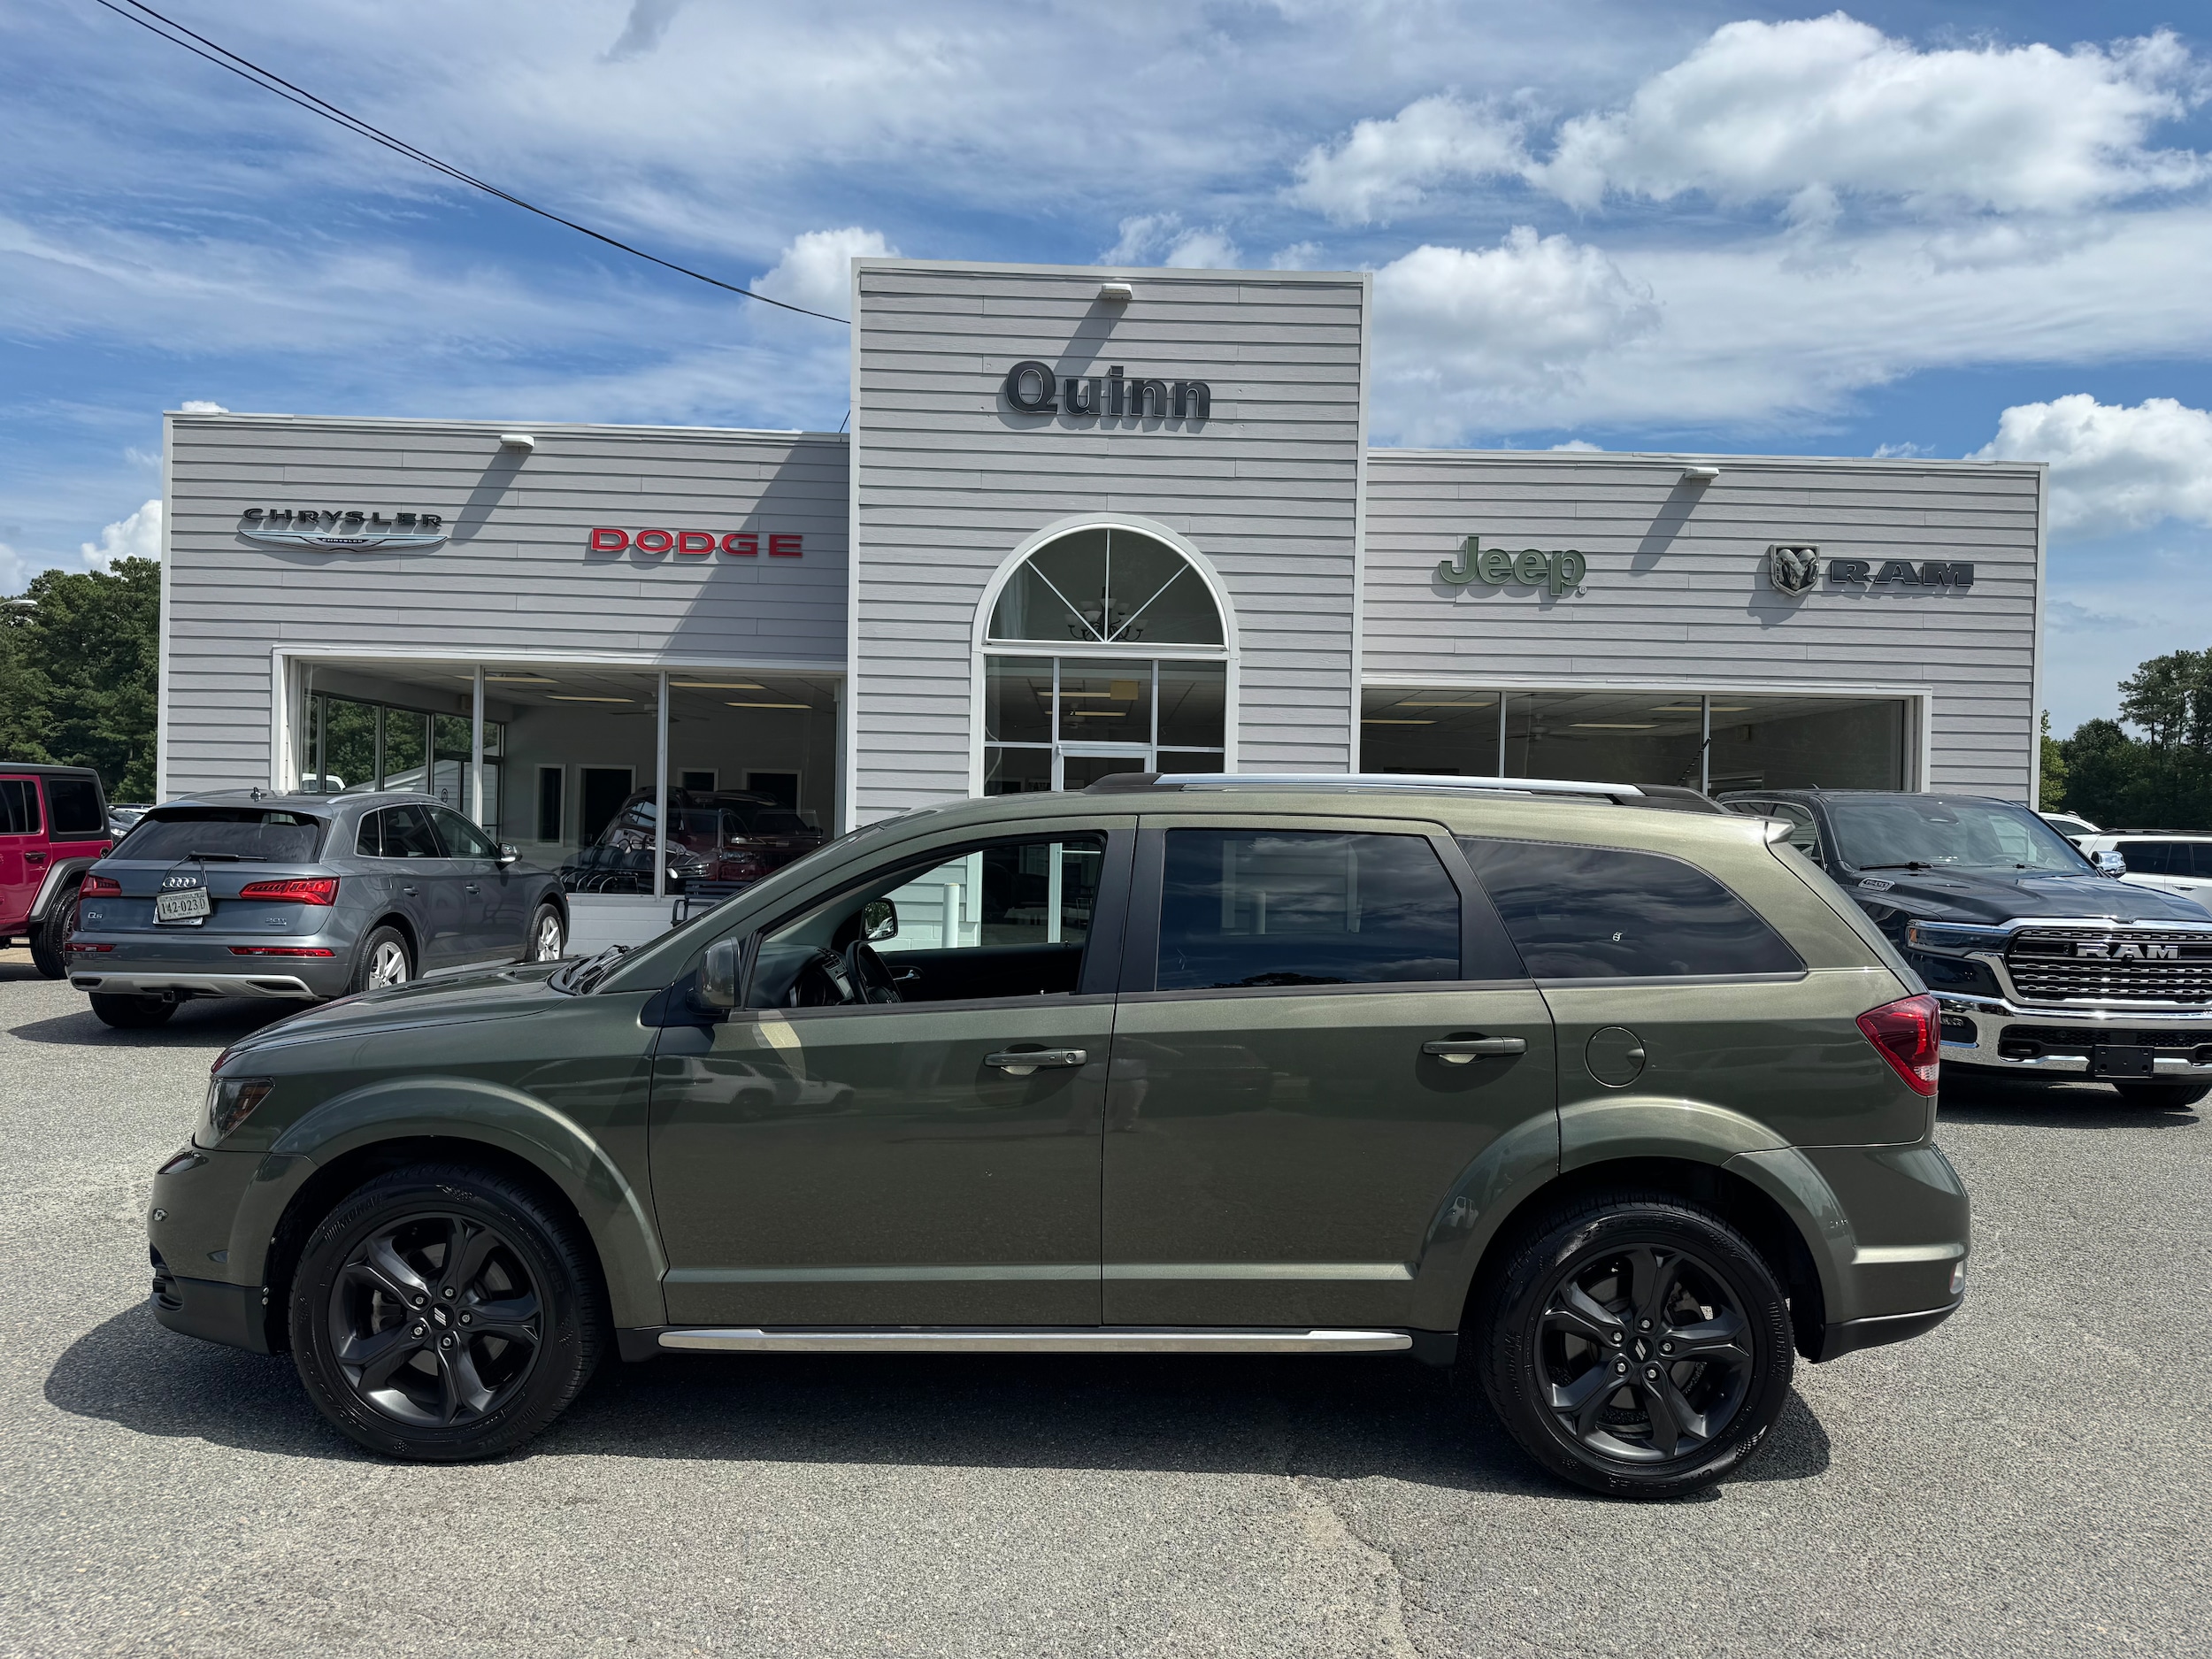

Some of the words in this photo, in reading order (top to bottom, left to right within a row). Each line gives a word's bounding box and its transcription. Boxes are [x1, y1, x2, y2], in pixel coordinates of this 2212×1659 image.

[1005, 360, 1211, 419] Quinn
[242, 508, 442, 527] CHRYSLER
[590, 527, 803, 557] DODGE
[1440, 535, 1586, 595] Jeep
[1832, 559, 1974, 586] RAM
[2076, 942, 2178, 959] RAM
